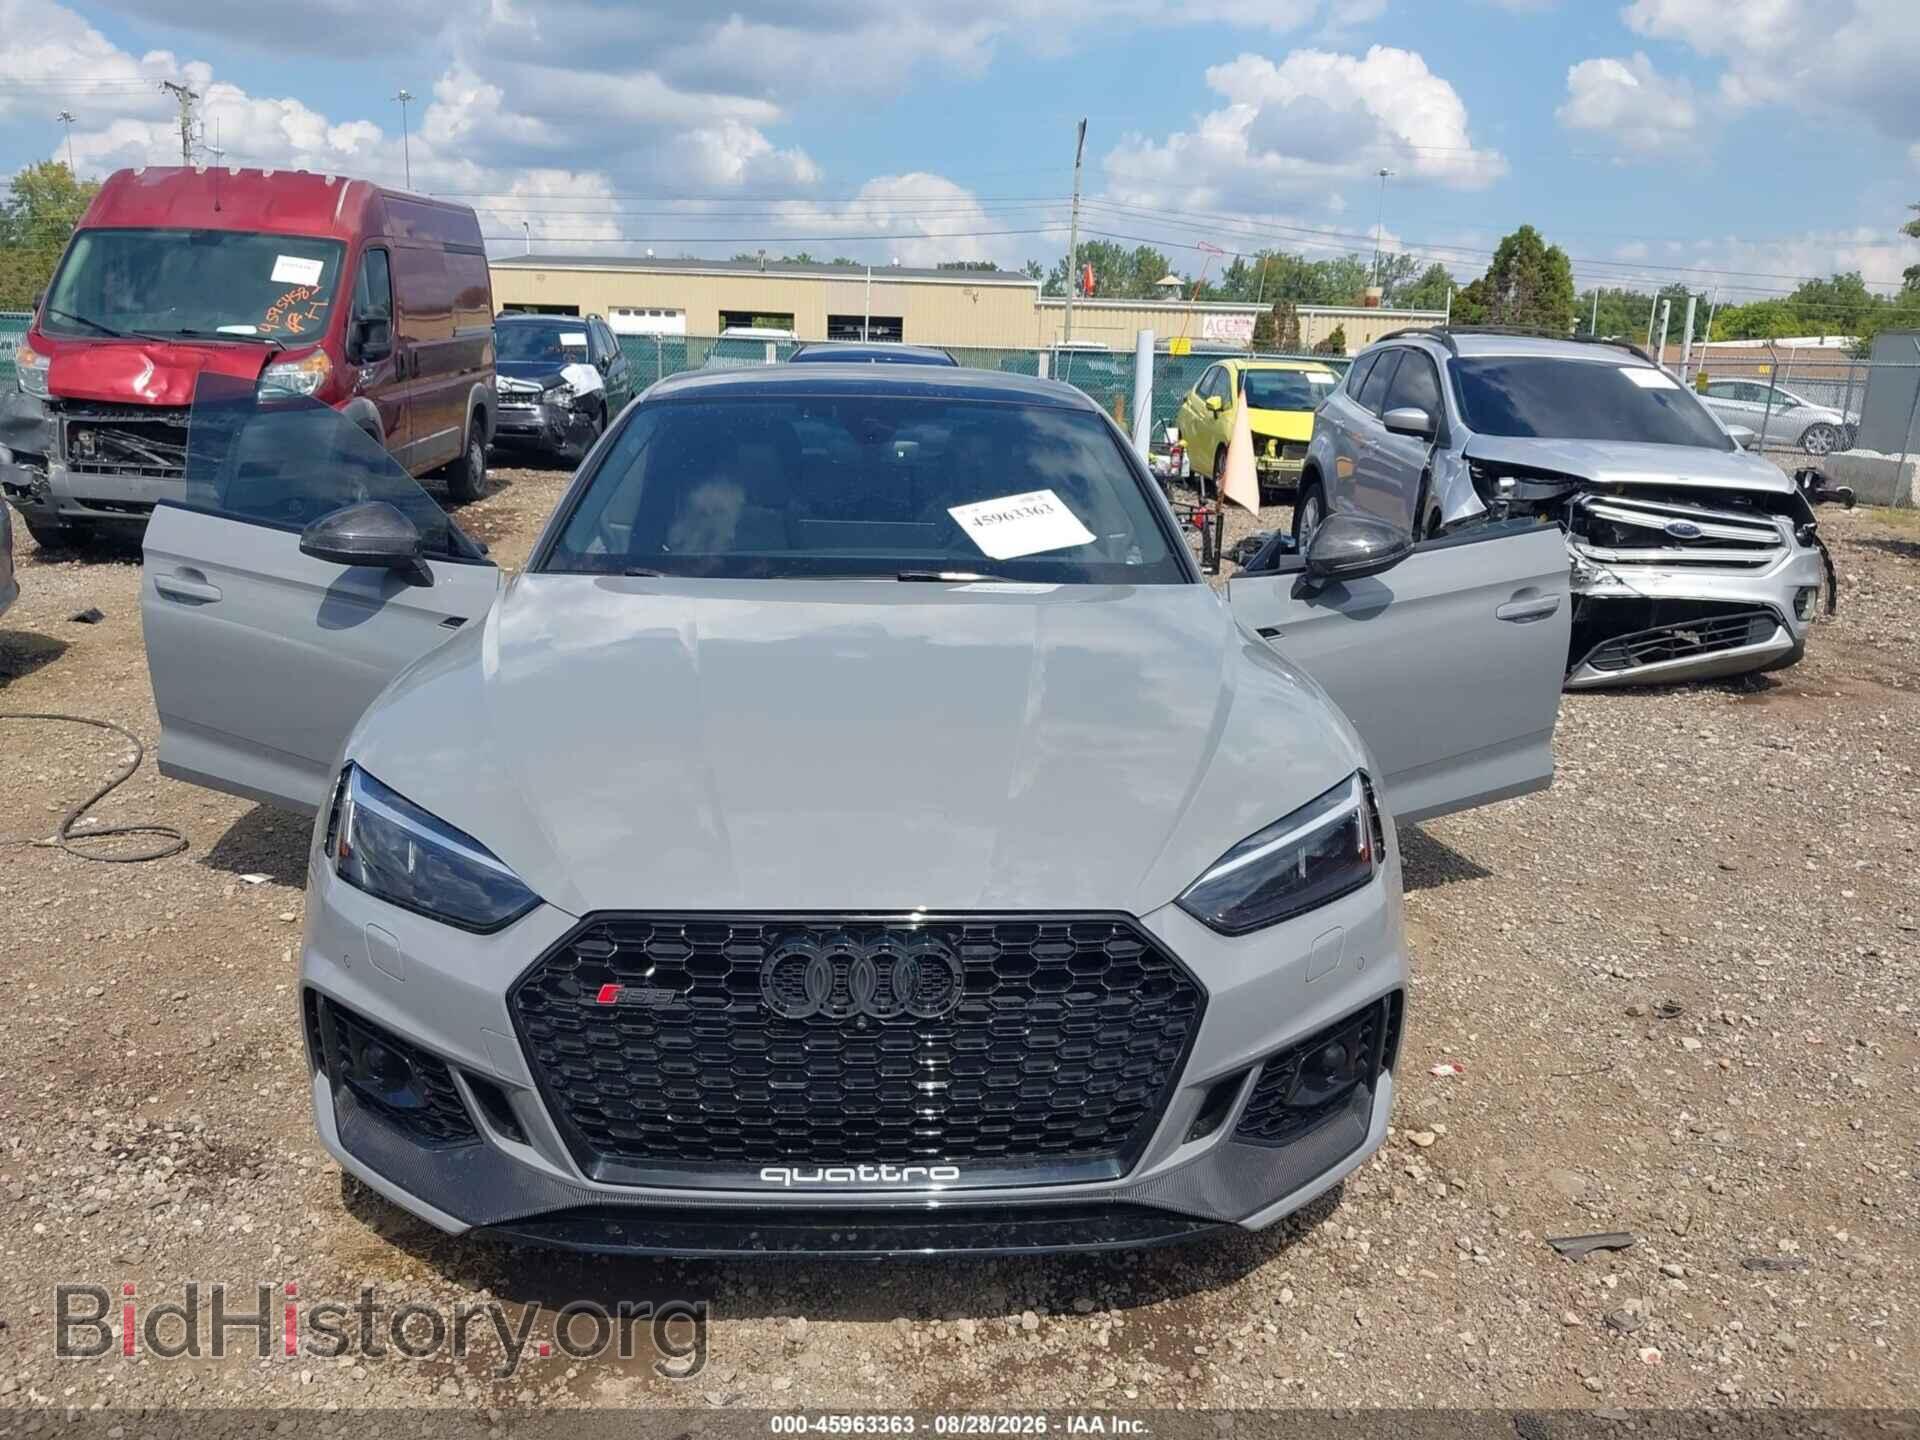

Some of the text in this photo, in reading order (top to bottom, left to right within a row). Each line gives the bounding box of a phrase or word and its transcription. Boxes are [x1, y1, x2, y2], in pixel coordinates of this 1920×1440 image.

[1206, 318, 1232, 332] ACE
[972, 503, 1055, 527] 45963363
[760, 1164, 960, 1186] quattro
